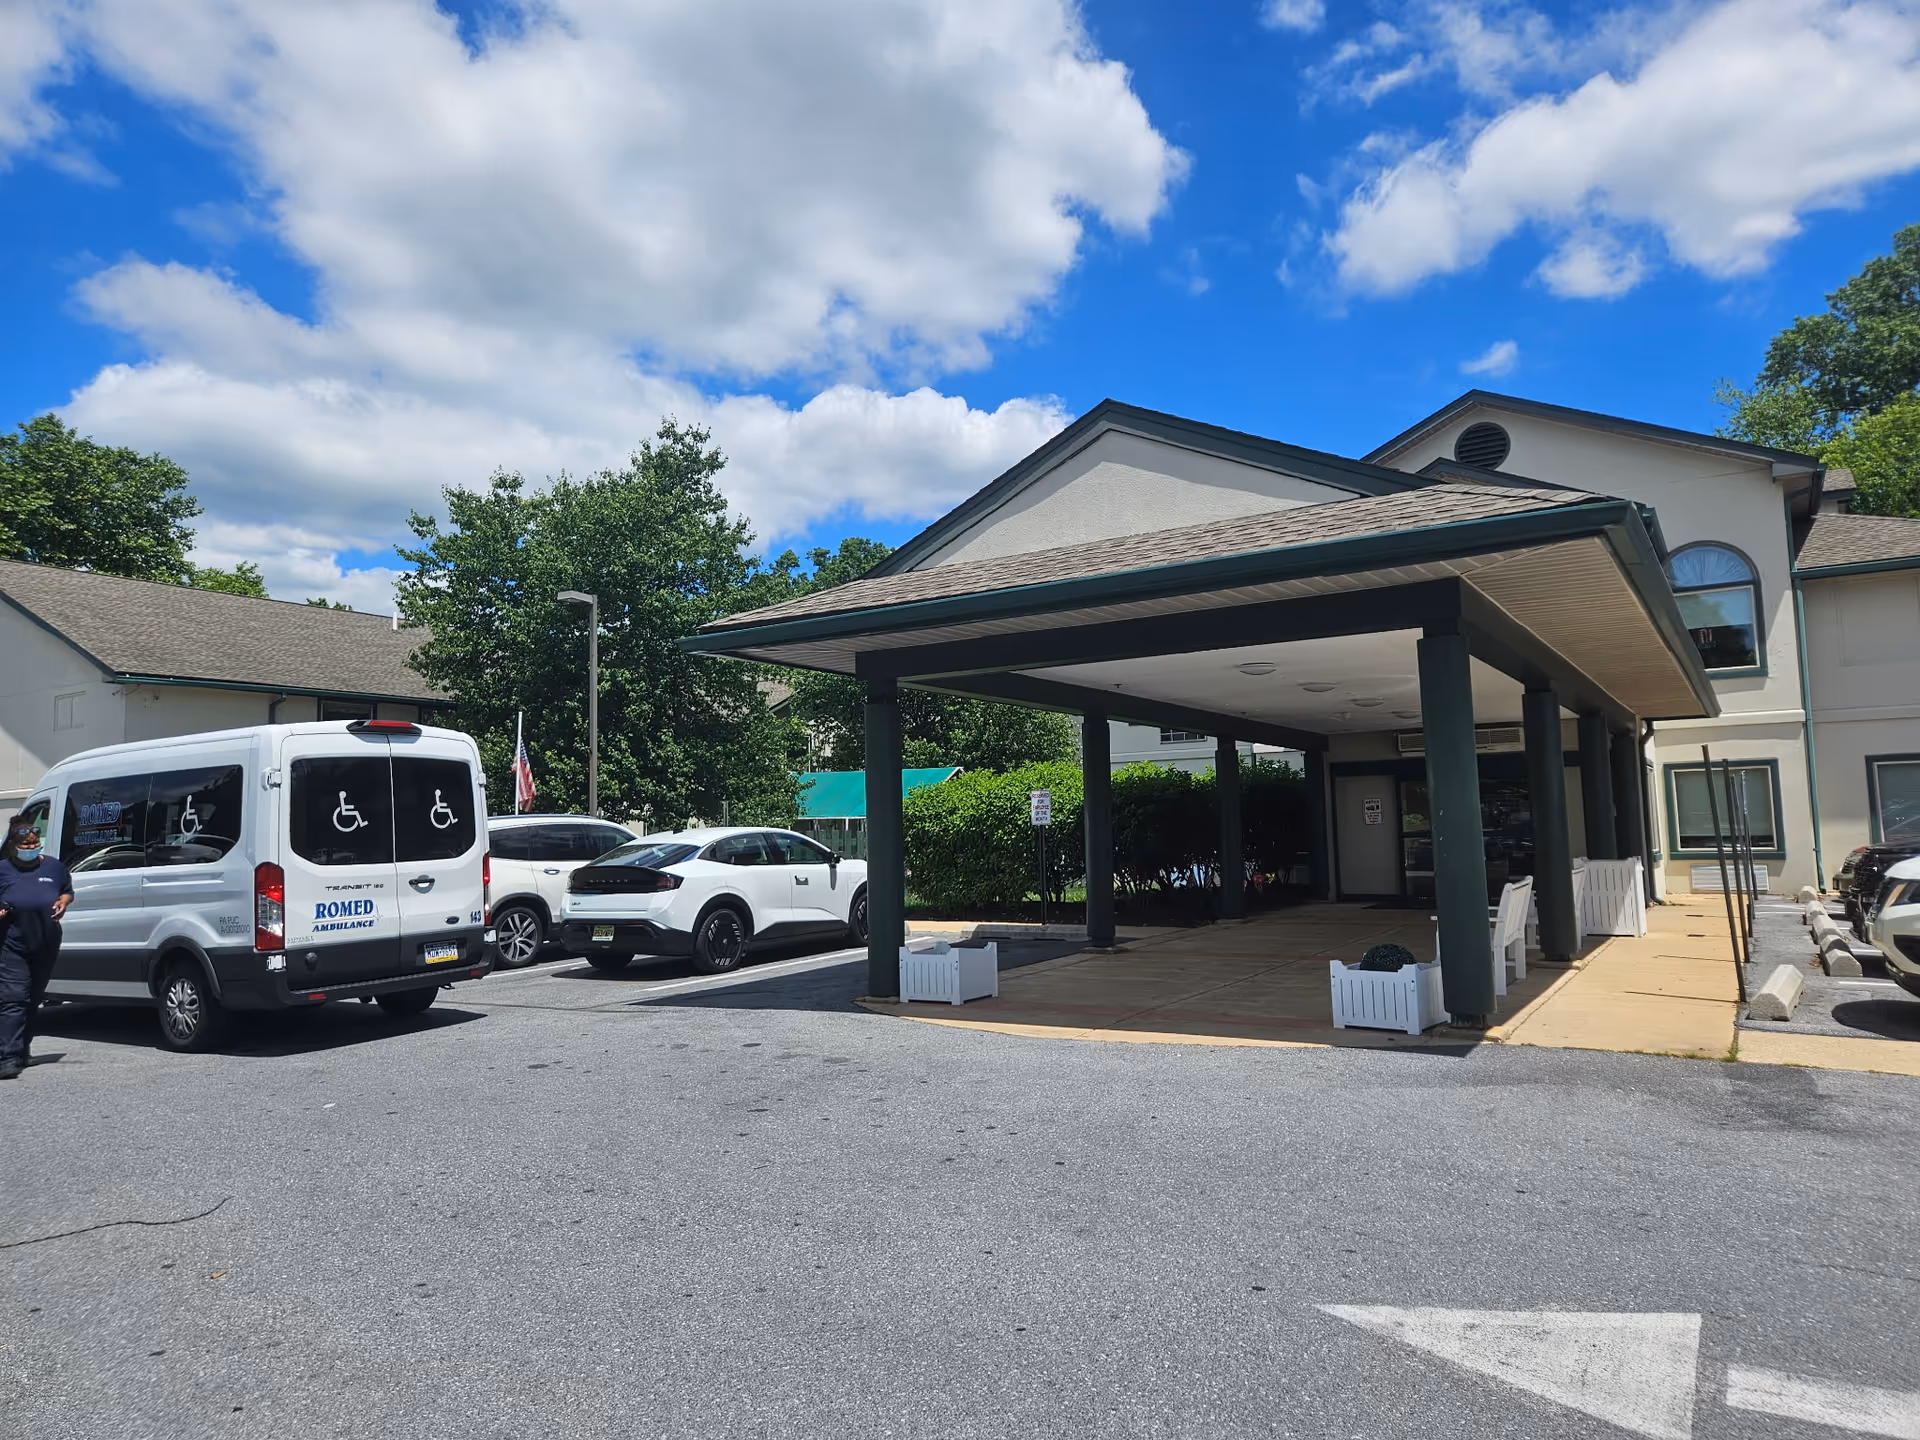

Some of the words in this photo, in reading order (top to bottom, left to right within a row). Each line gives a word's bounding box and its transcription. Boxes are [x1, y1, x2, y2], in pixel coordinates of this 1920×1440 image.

[80, 801, 121, 826] ROMED
[315, 899, 374, 919] ROMED
[470, 910, 481, 923] 143
[312, 919, 375, 932] AMBULANCE
